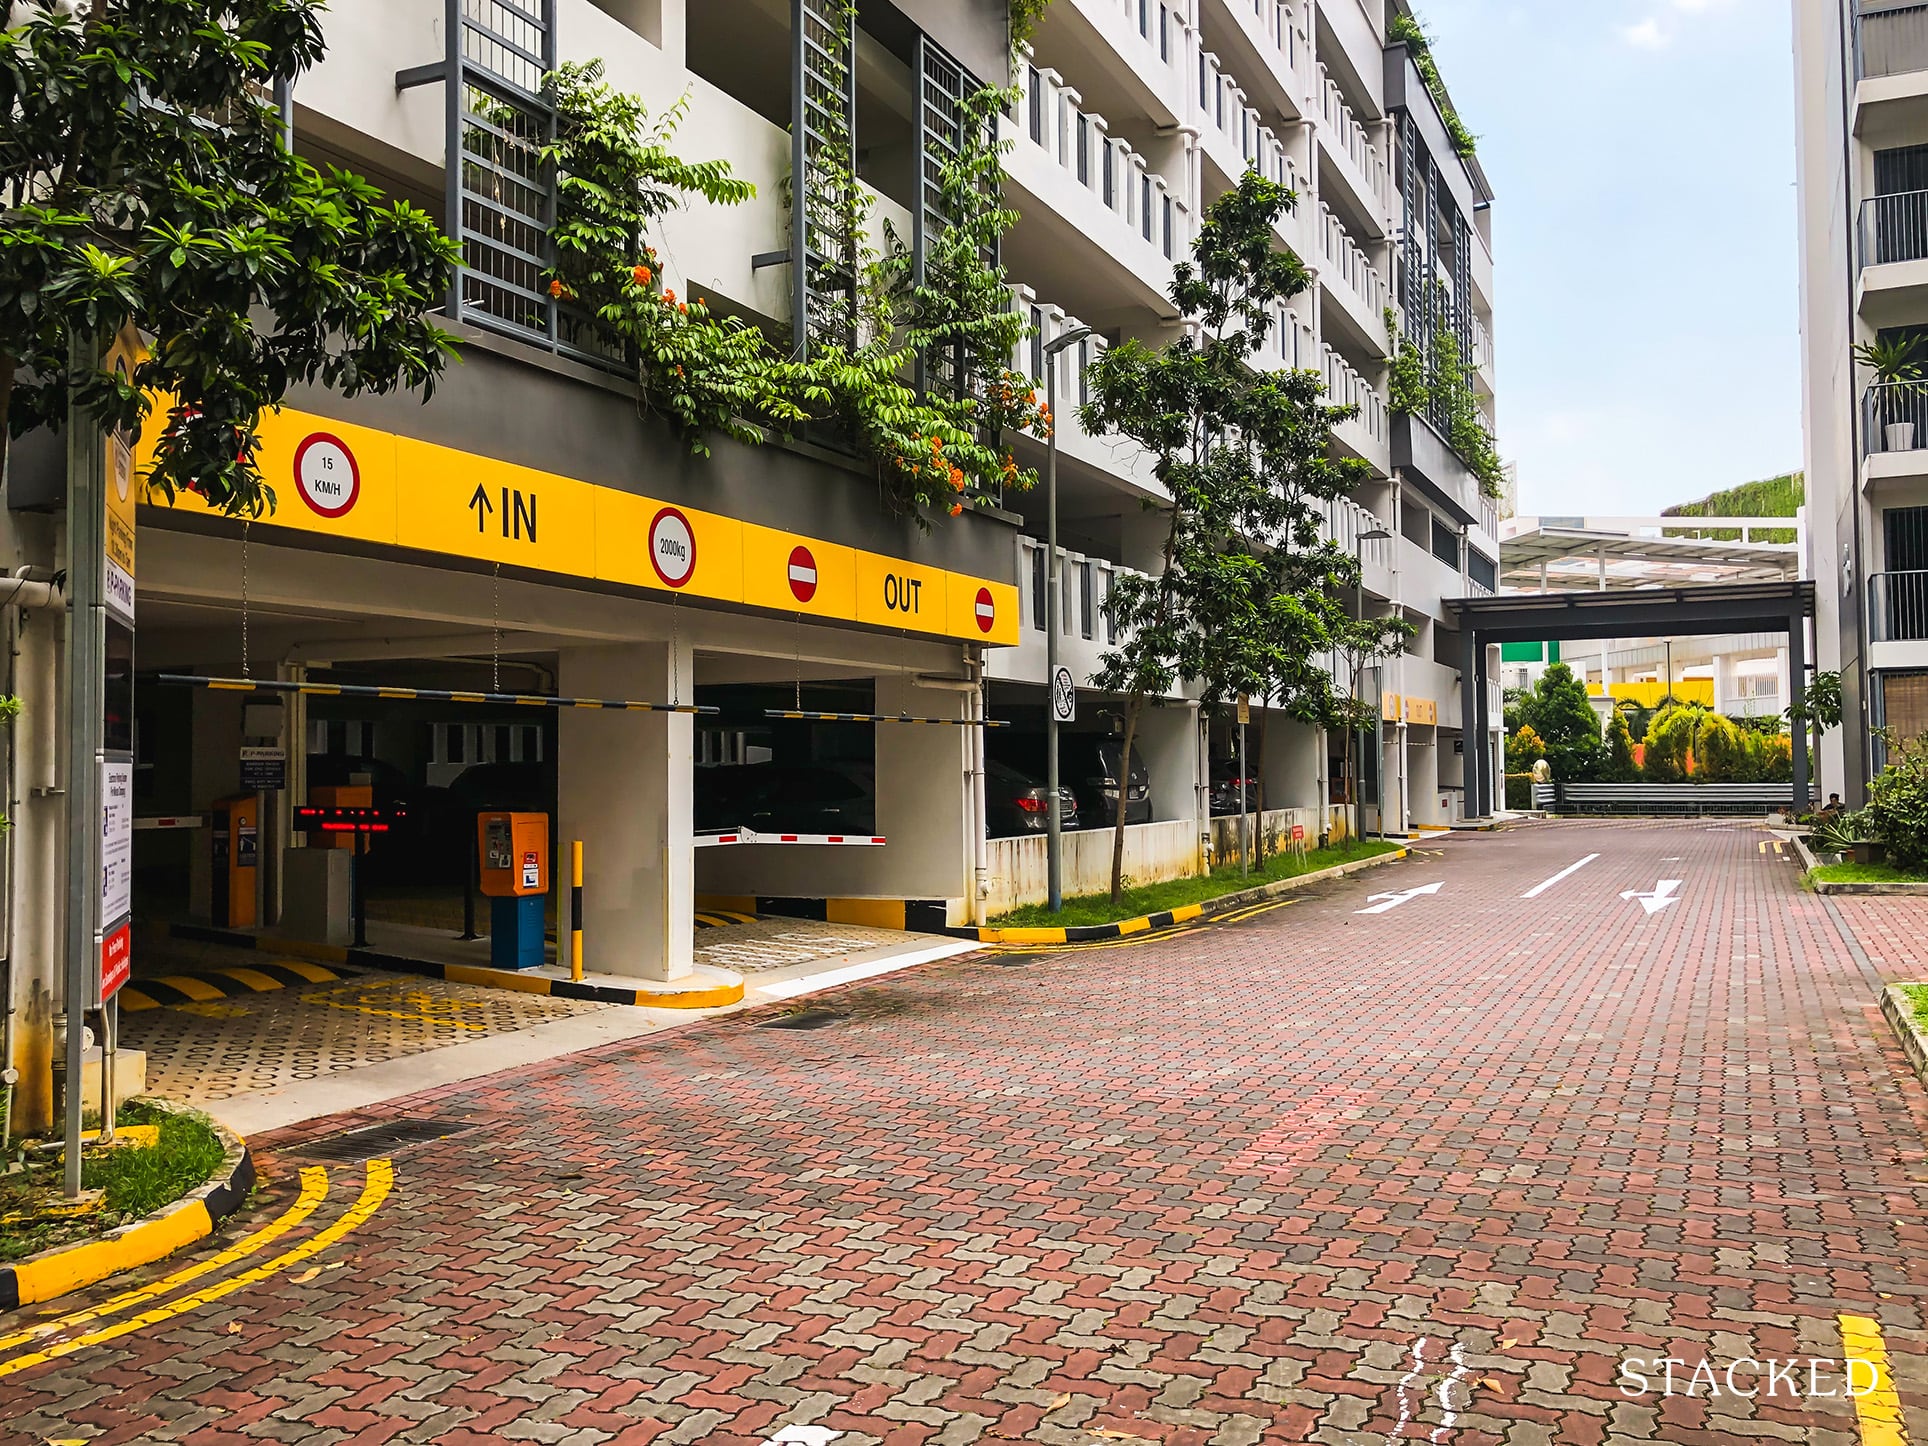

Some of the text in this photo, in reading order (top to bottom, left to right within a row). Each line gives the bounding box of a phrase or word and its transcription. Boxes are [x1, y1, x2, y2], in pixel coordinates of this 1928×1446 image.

[322, 457, 333, 470] 15
[315, 479, 341, 496] KM/H
[502, 486, 537, 543] IN
[660, 538, 686, 562] 2000kg
[884, 573, 922, 614] OUT
